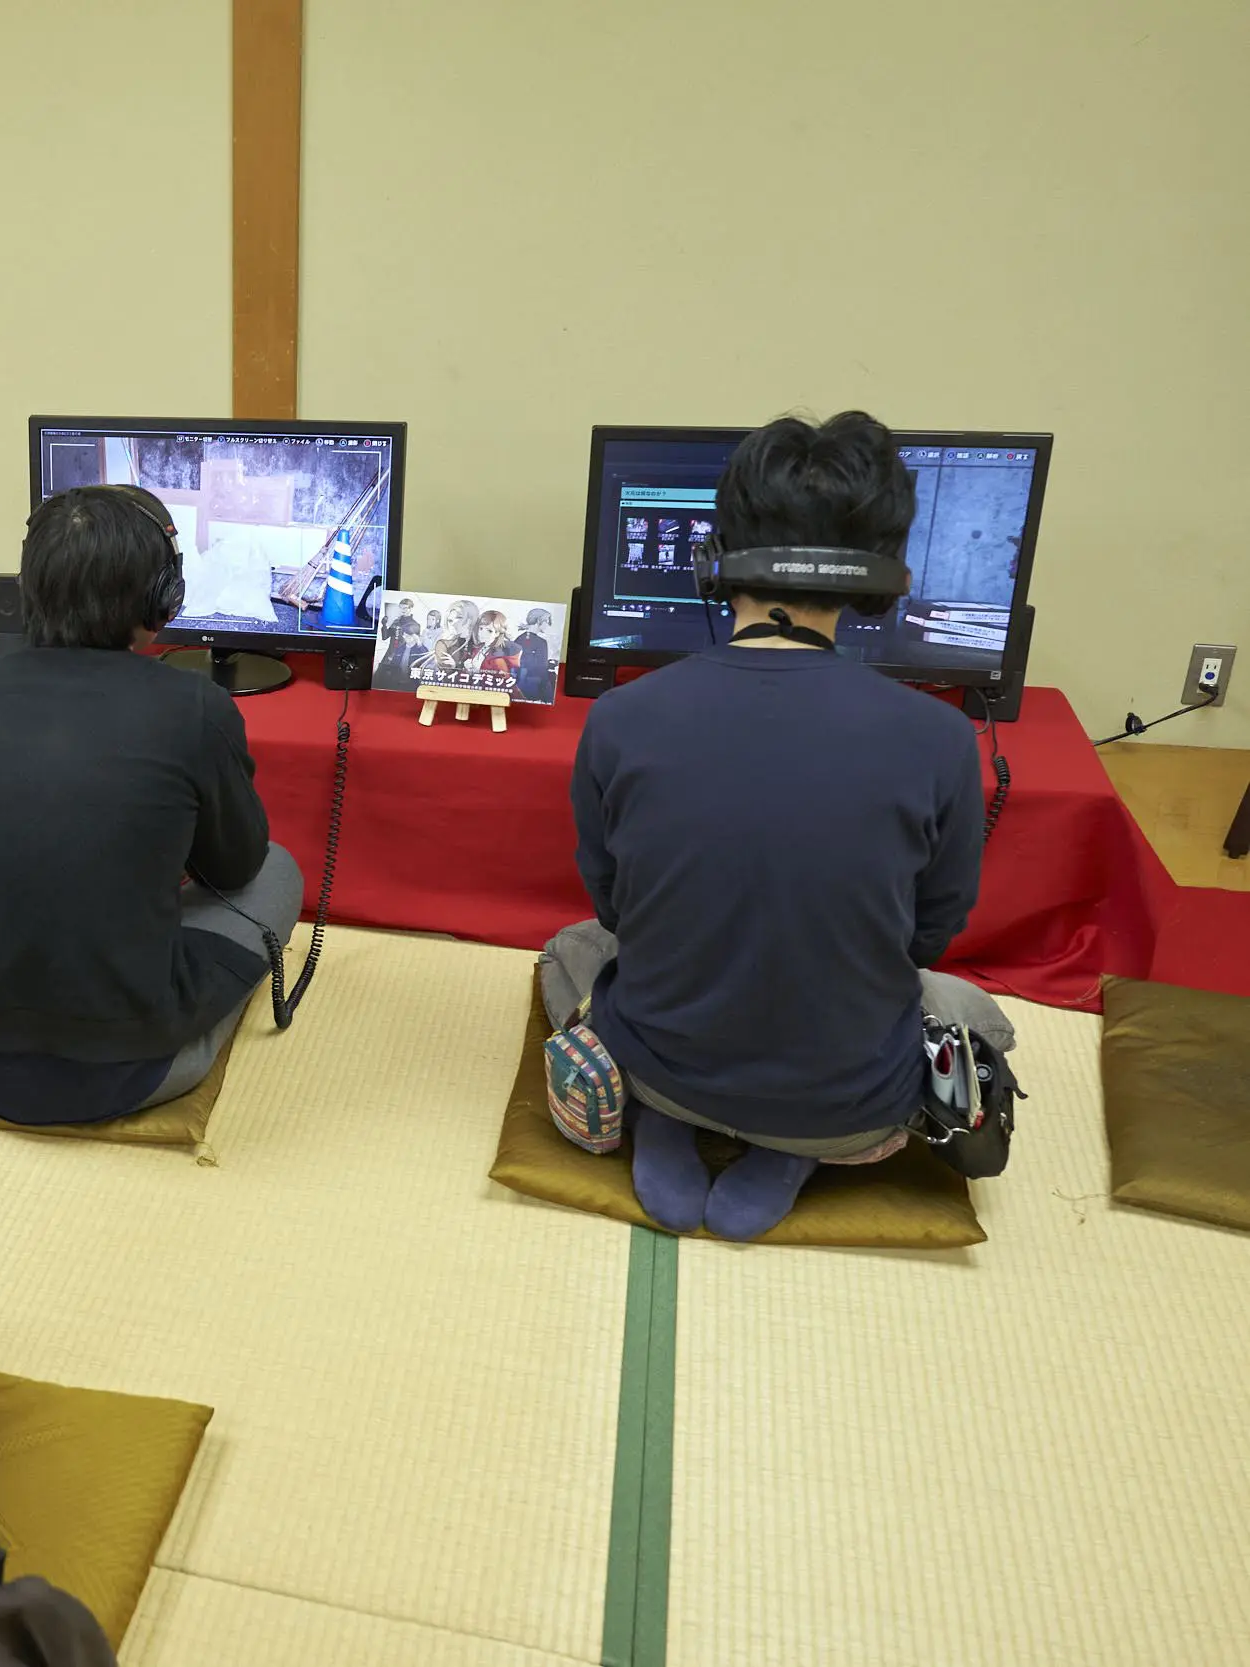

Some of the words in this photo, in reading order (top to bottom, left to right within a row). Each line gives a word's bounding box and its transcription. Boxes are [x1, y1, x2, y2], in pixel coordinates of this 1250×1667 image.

[290, 437, 310, 446] ファイル
[772, 562, 815, 574] STUDIO
[818, 563, 868, 576] MONITOR
[409, 667, 517, 688] 東京サイコデミック
